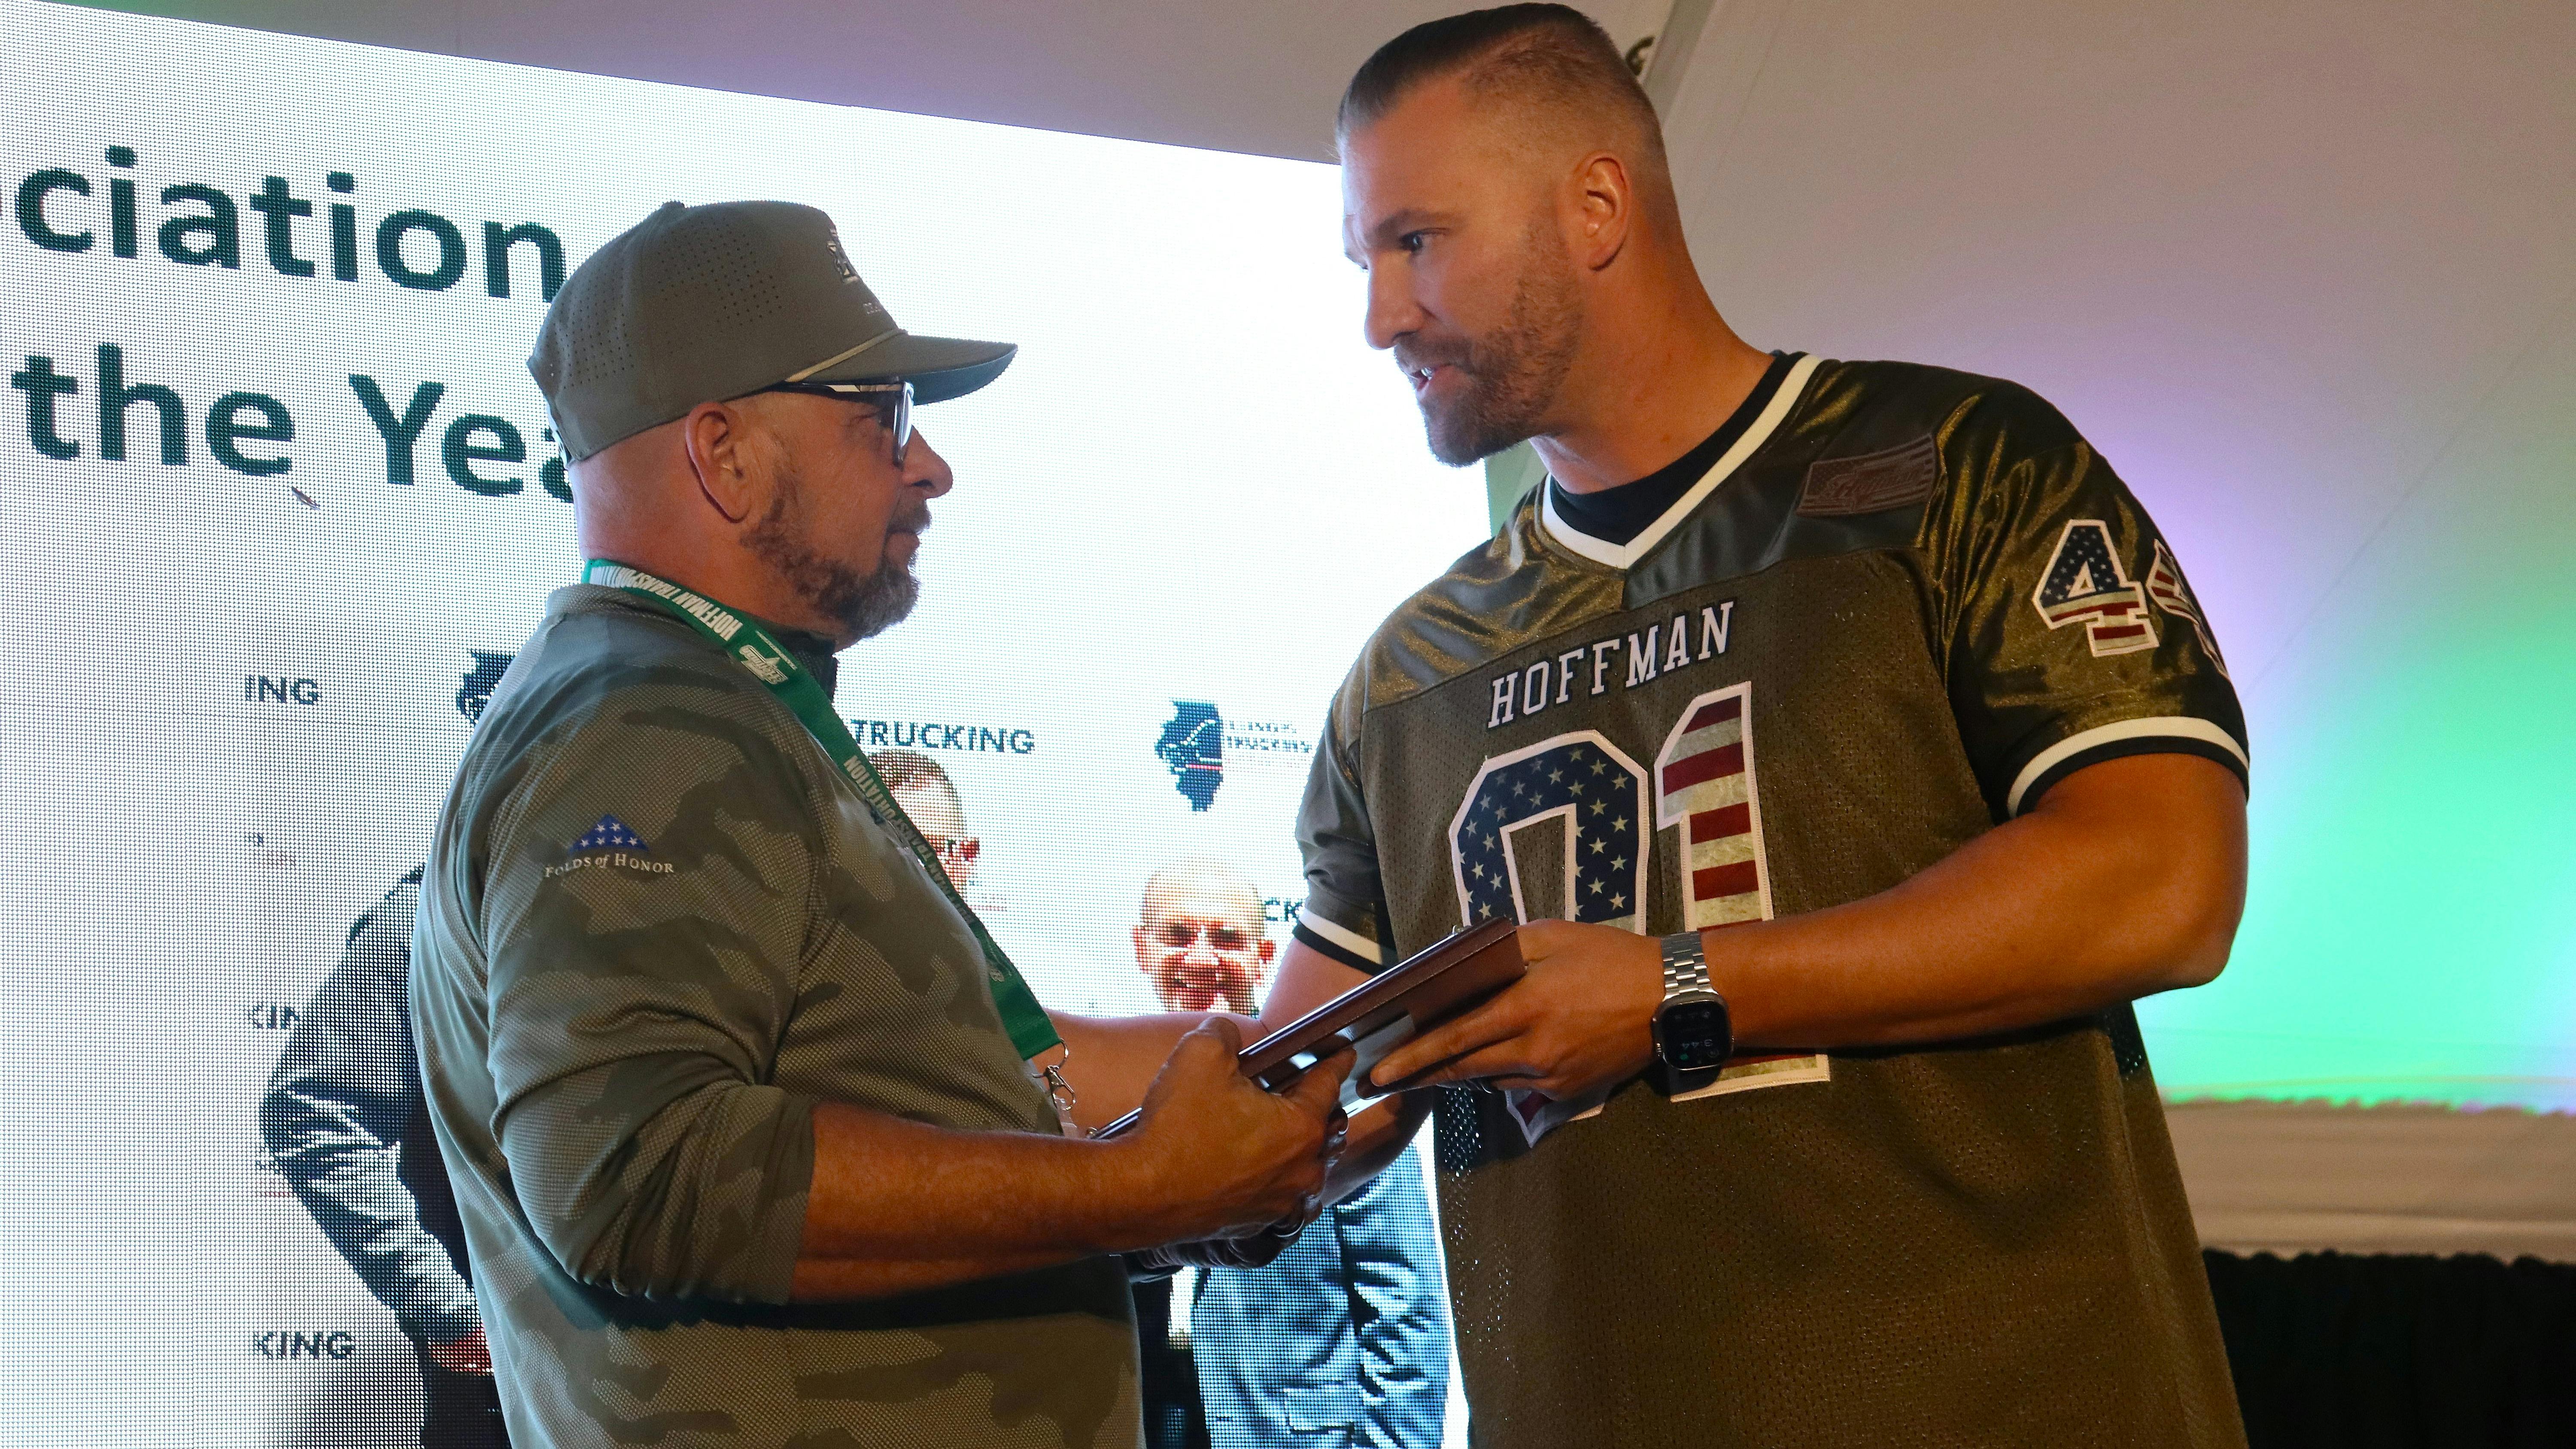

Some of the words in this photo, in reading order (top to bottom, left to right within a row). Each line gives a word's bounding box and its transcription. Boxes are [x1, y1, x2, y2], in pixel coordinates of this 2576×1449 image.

[0, 144, 566, 302] ciation
[11, 342, 295, 476] the
[672, 592, 743, 642] HOFFMAN
[245, 674, 319, 705] ING
[1486, 600, 1735, 729] HOFFMAN
[851, 719, 1035, 754] TRUCKING
[544, 856, 592, 878] FOLDS
[595, 854, 611, 869] of
[614, 853, 674, 874] HONOR
